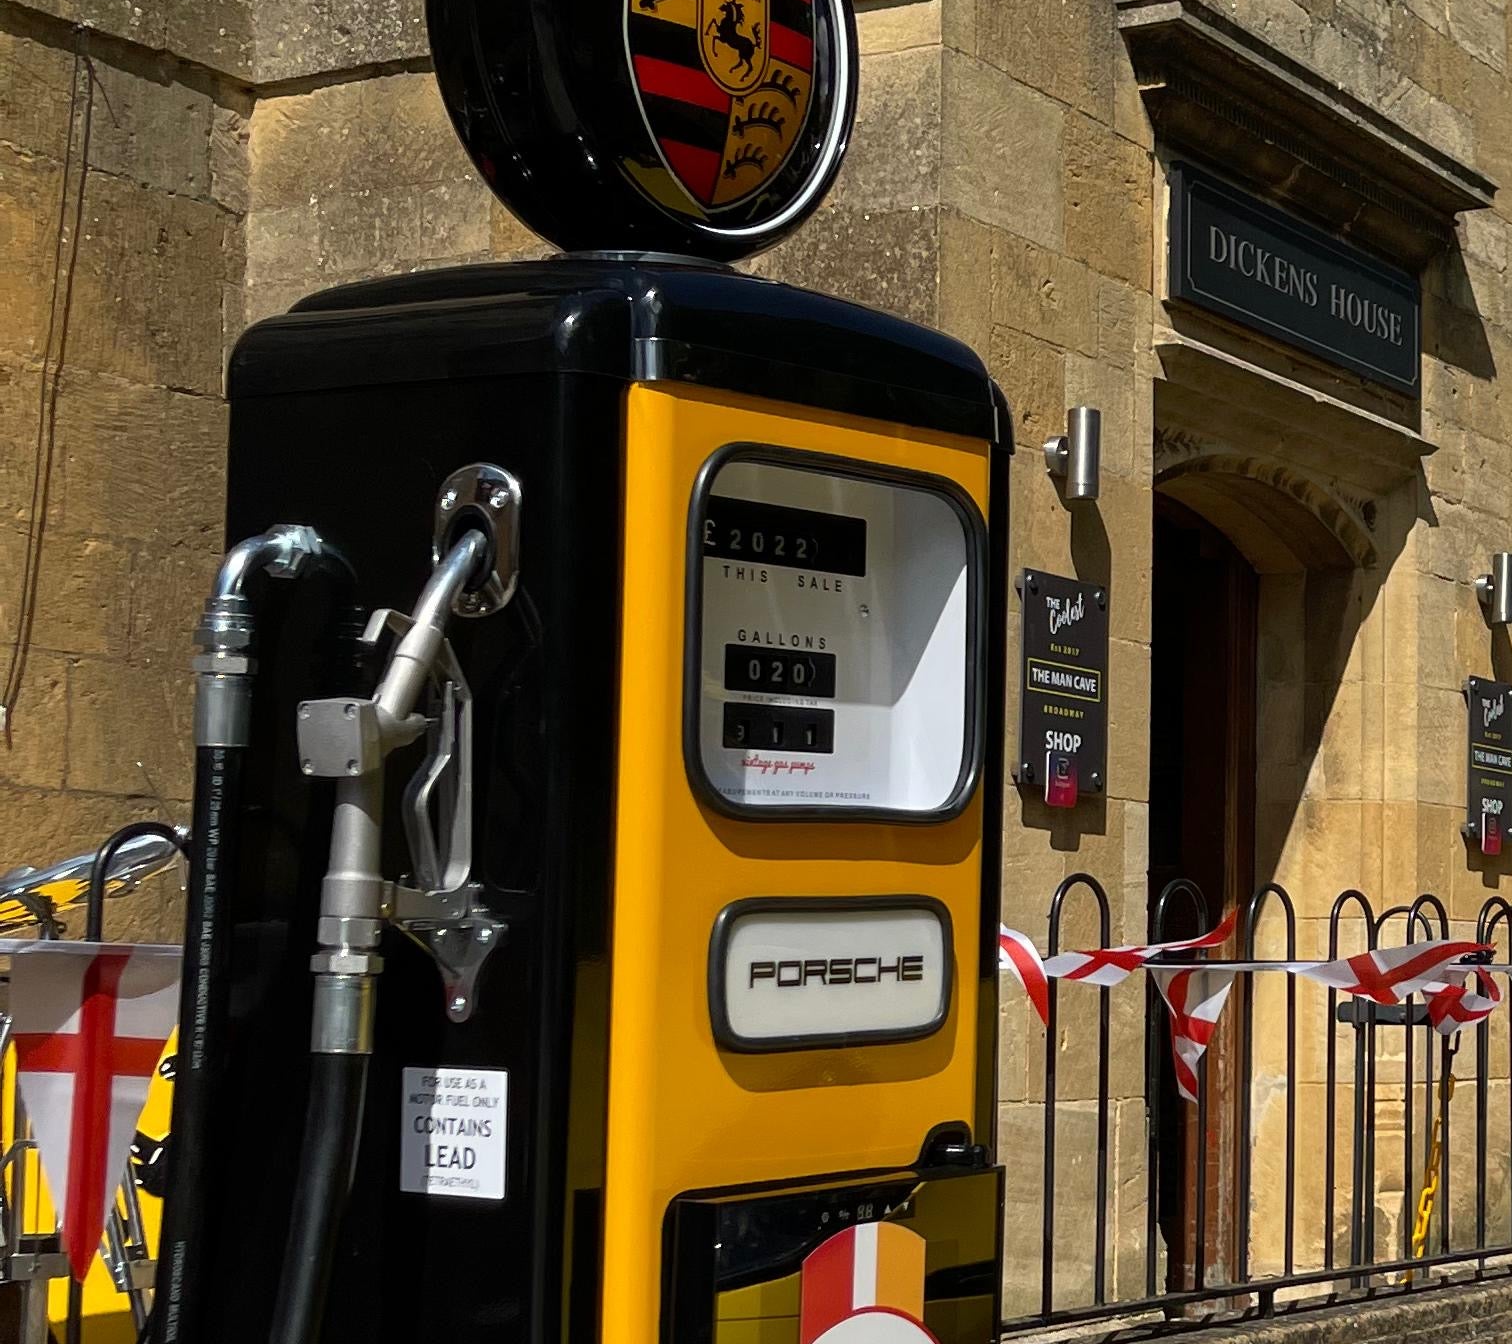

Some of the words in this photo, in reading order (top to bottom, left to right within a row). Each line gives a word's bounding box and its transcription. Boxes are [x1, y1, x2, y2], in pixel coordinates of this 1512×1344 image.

[1208, 225, 1319, 308] DICKENS
[1330, 283, 1403, 347] HOUSE
[722, 565, 769, 584] THIS
[797, 575, 844, 593] SALE
[1046, 596, 1061, 609] THE
[1049, 592, 1085, 635] Coolest
[737, 628, 828, 650] GALLONS
[1032, 667, 1051, 684] THE
[1051, 671, 1073, 688] MAN
[1073, 675, 1097, 693] CAVE
[1045, 730, 1082, 752] SHOP
[1482, 797, 1504, 815] SHOP
[749, 955, 924, 989] PORSCHE
[422, 1076, 442, 1088] FOR
[444, 1077, 464, 1089] USE
[465, 1078, 477, 1090] AS
[478, 1079, 487, 1090] A
[445, 1095, 470, 1107] FUEL
[472, 1096, 500, 1108] ONLY
[413, 1115, 493, 1138] CONTAINS
[424, 1144, 476, 1170] LEAD
